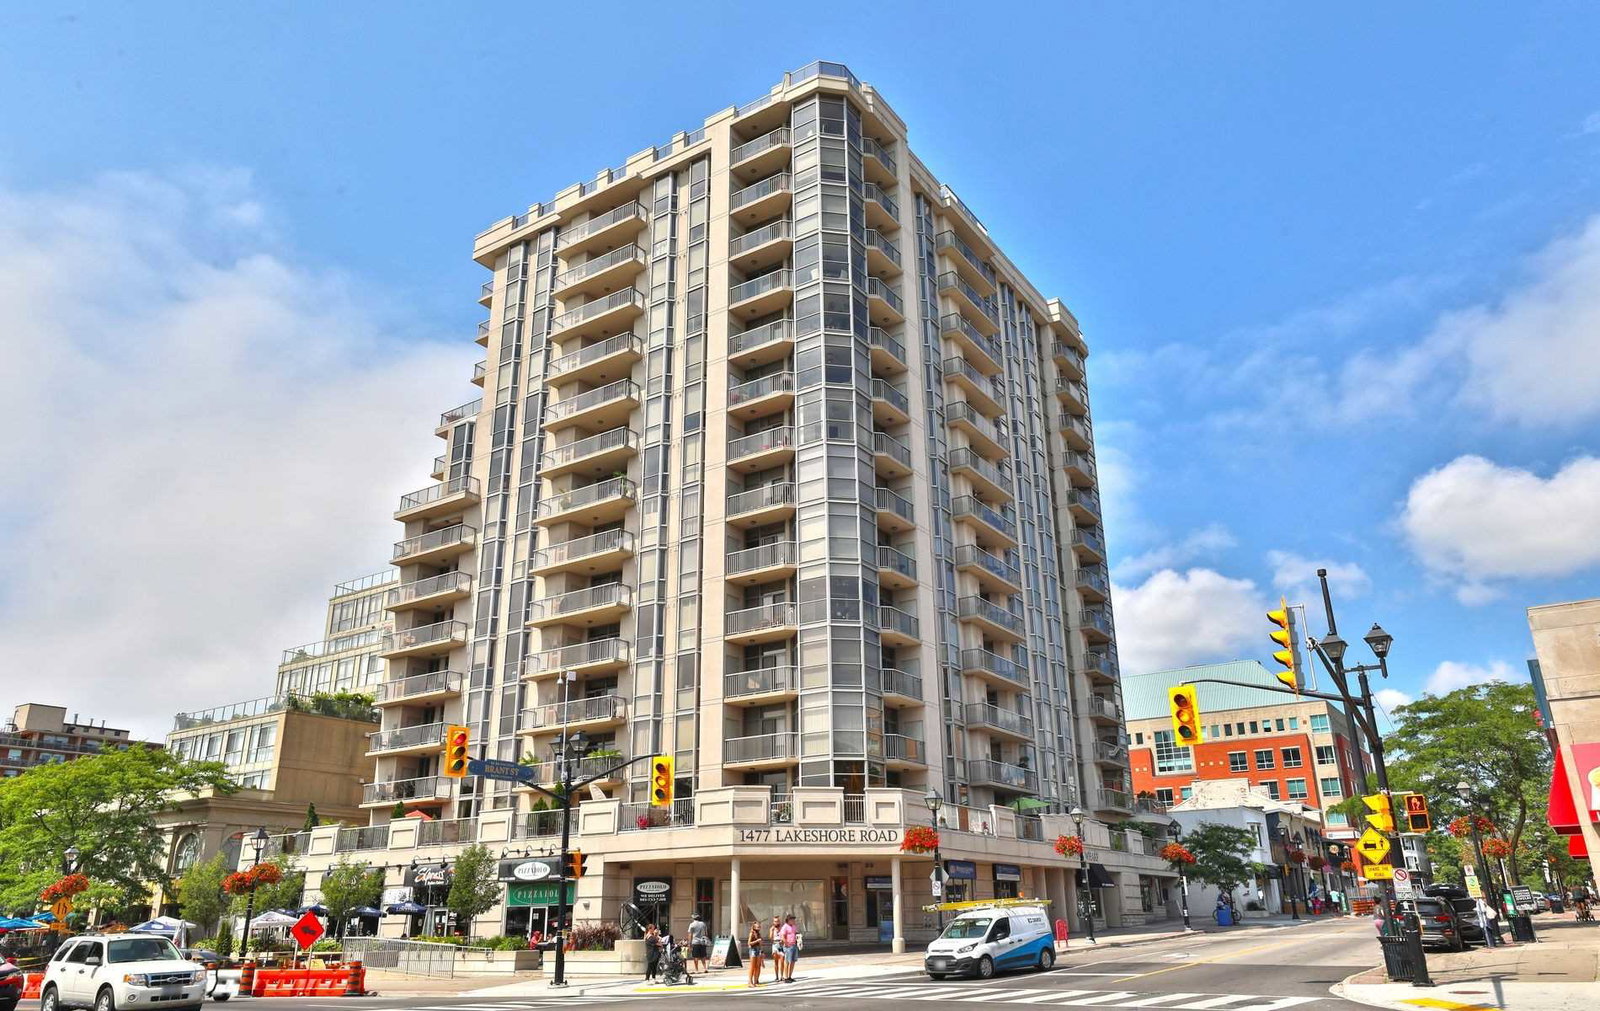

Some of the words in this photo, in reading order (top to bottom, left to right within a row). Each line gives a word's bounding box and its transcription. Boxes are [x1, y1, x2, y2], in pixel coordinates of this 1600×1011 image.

[485, 764, 510, 775] BRANT
[740, 830, 770, 842] 1477
[776, 830, 855, 842] LAKESHORE
[860, 830, 898, 842] ROAD
[517, 888, 560, 899] PIZZAIOL
